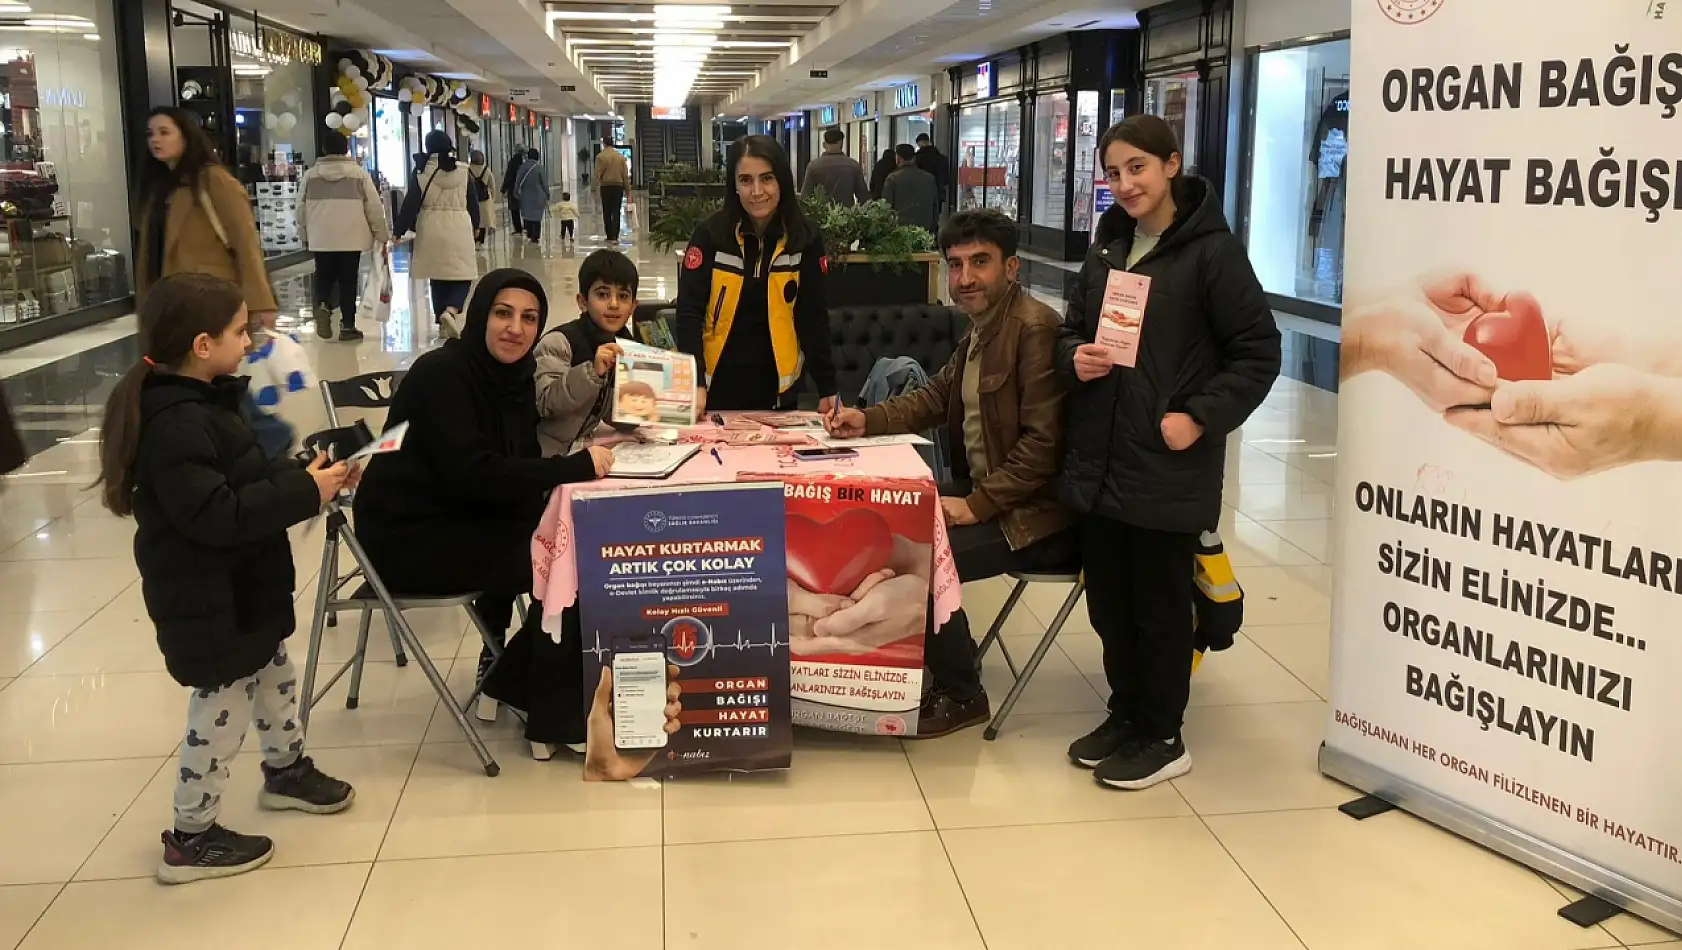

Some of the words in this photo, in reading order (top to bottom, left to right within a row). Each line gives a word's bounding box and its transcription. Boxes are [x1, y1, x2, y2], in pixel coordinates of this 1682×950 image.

[1382, 62, 1522, 112] ORGAN
[1539, 43, 1682, 119] BAĞIŞ
[1385, 158, 1511, 203] HAYAT
[784, 480, 832, 503] BAĞIŞ
[838, 484, 865, 502] BİR
[870, 488, 922, 505] HAYAT
[1355, 481, 1482, 541] ONLARIN
[1492, 513, 1682, 595] HAYATLARI
[601, 545, 656, 558] HAYAT
[660, 539, 762, 555] KURTARMAK
[609, 560, 658, 575] ARTIK
[662, 559, 697, 576] ÇOK
[701, 557, 756, 571] KOLAY
[1378, 540, 1451, 593] SİZİN
[1462, 569, 1646, 651] ELİNİZDE...
[646, 608, 670, 617] Kolay
[692, 605, 723, 613] Güvenli
[1383, 601, 1633, 711] ORGANLARINIZI
[832, 667, 861, 681] SİZİN
[715, 680, 766, 690] ORGAN
[850, 685, 906, 700] BAĞIŞLAYIN
[716, 693, 766, 707] BAĞIŞI
[718, 710, 766, 720] HAYAT
[1406, 664, 1595, 762] BAĞIŞLAYIN
[693, 726, 766, 738] KURTARIR
[1335, 709, 1409, 750] BAĞIŞLANAN
[1412, 739, 1436, 762] HER
[1440, 752, 1489, 783] ORGAN
[1493, 771, 1571, 818] FİLİZLENEN
[1576, 807, 1599, 829] BİR
[1603, 819, 1682, 864] HAYATTIR.
